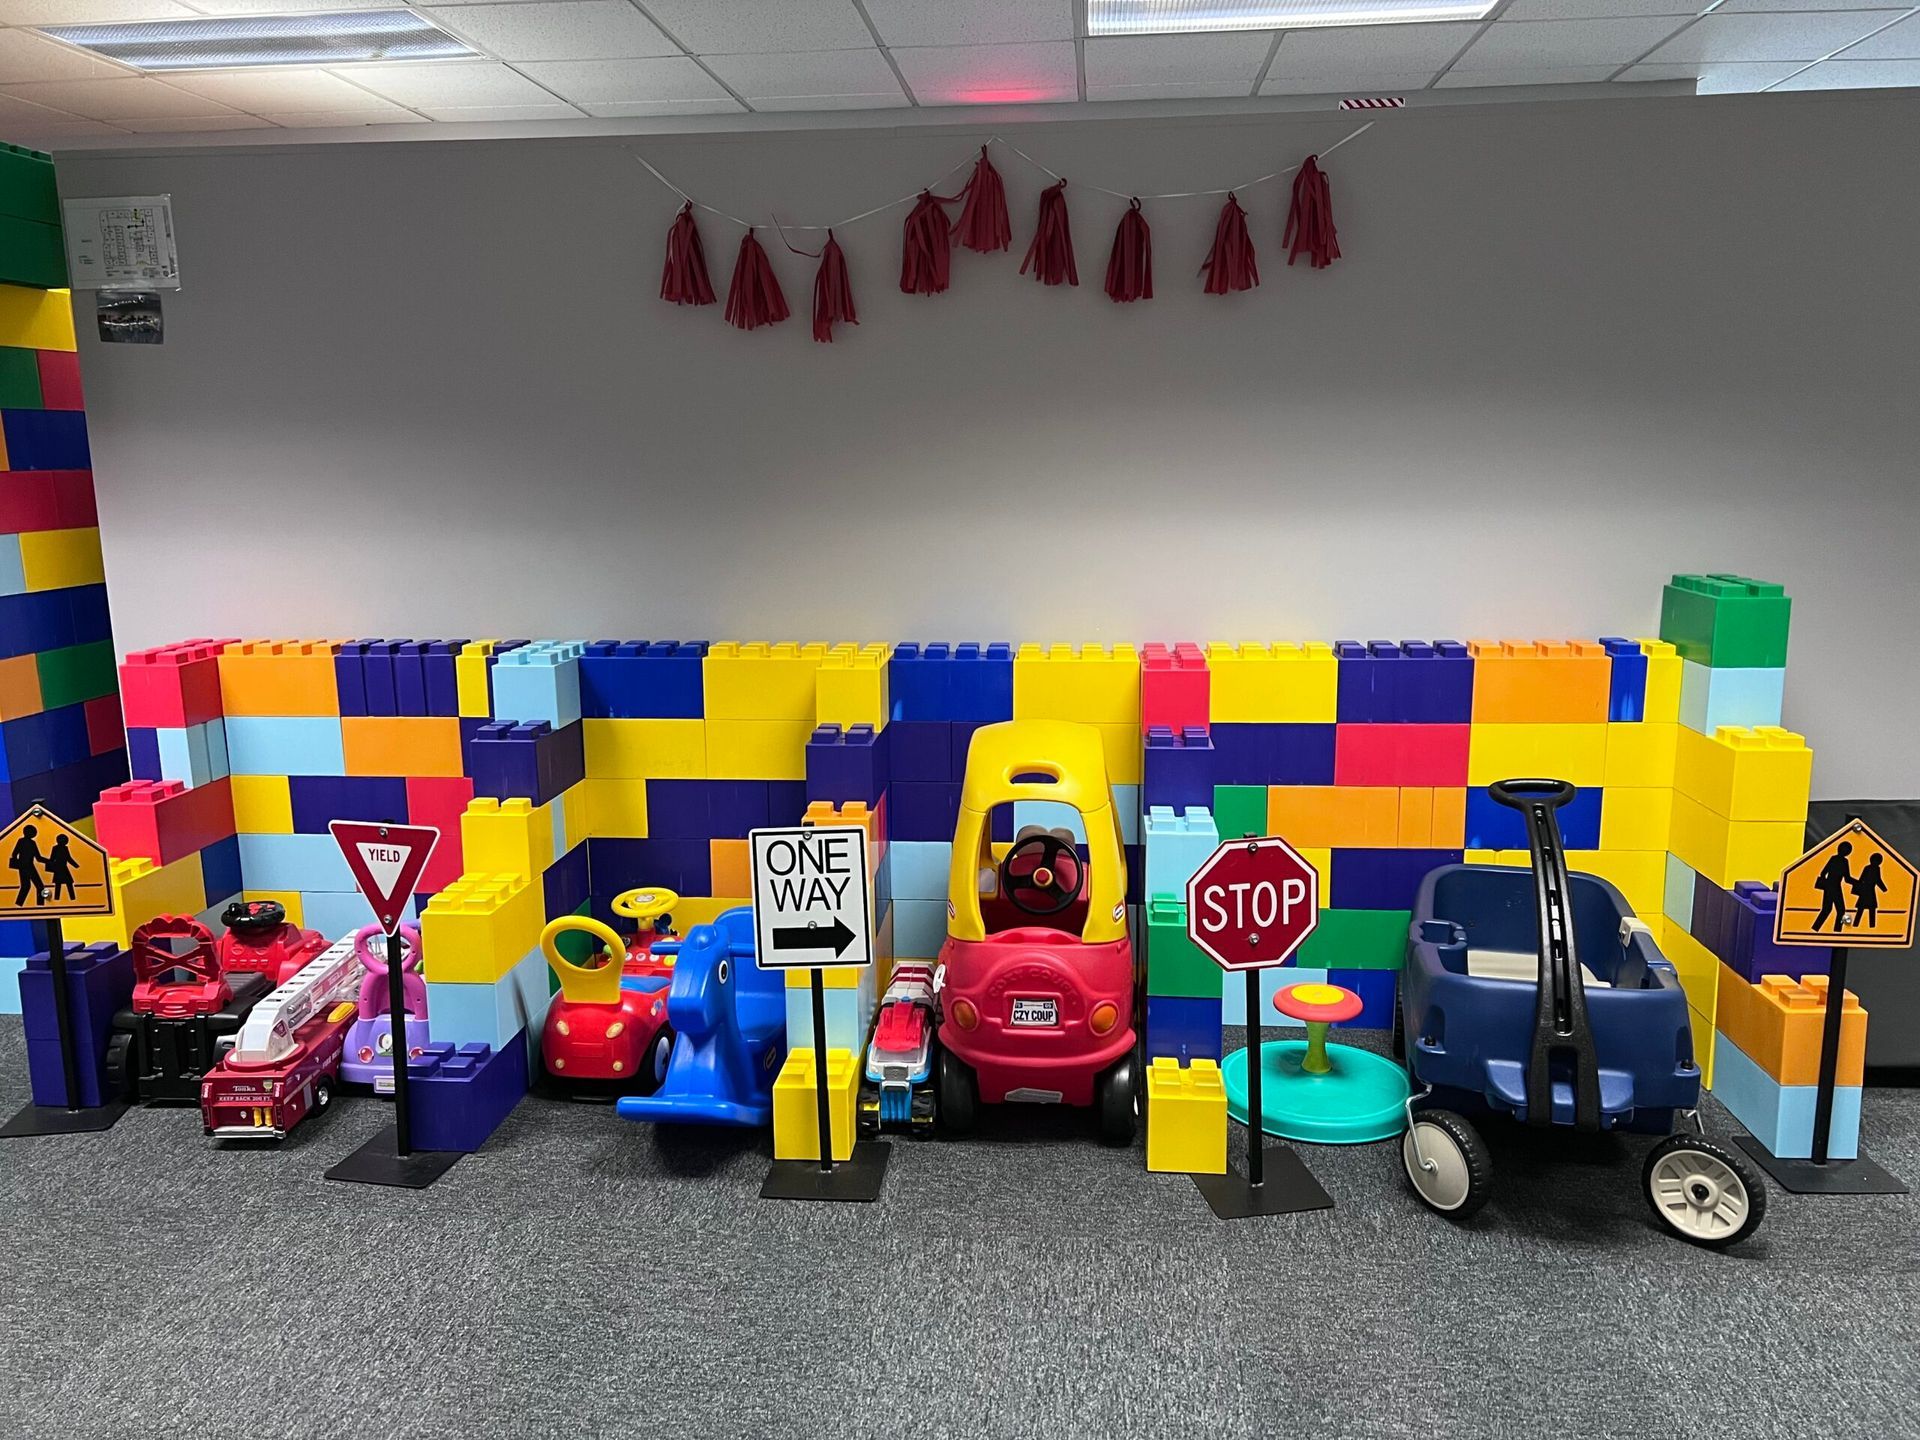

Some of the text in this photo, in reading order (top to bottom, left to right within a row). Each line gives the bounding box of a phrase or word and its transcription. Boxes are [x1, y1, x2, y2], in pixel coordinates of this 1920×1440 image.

[368, 848, 400, 863] YIELD
[766, 838, 851, 876] ONE
[770, 877, 851, 912] WAY
[1202, 878, 1306, 933] STOP
[1013, 1010, 1054, 1021] CZY COUP
